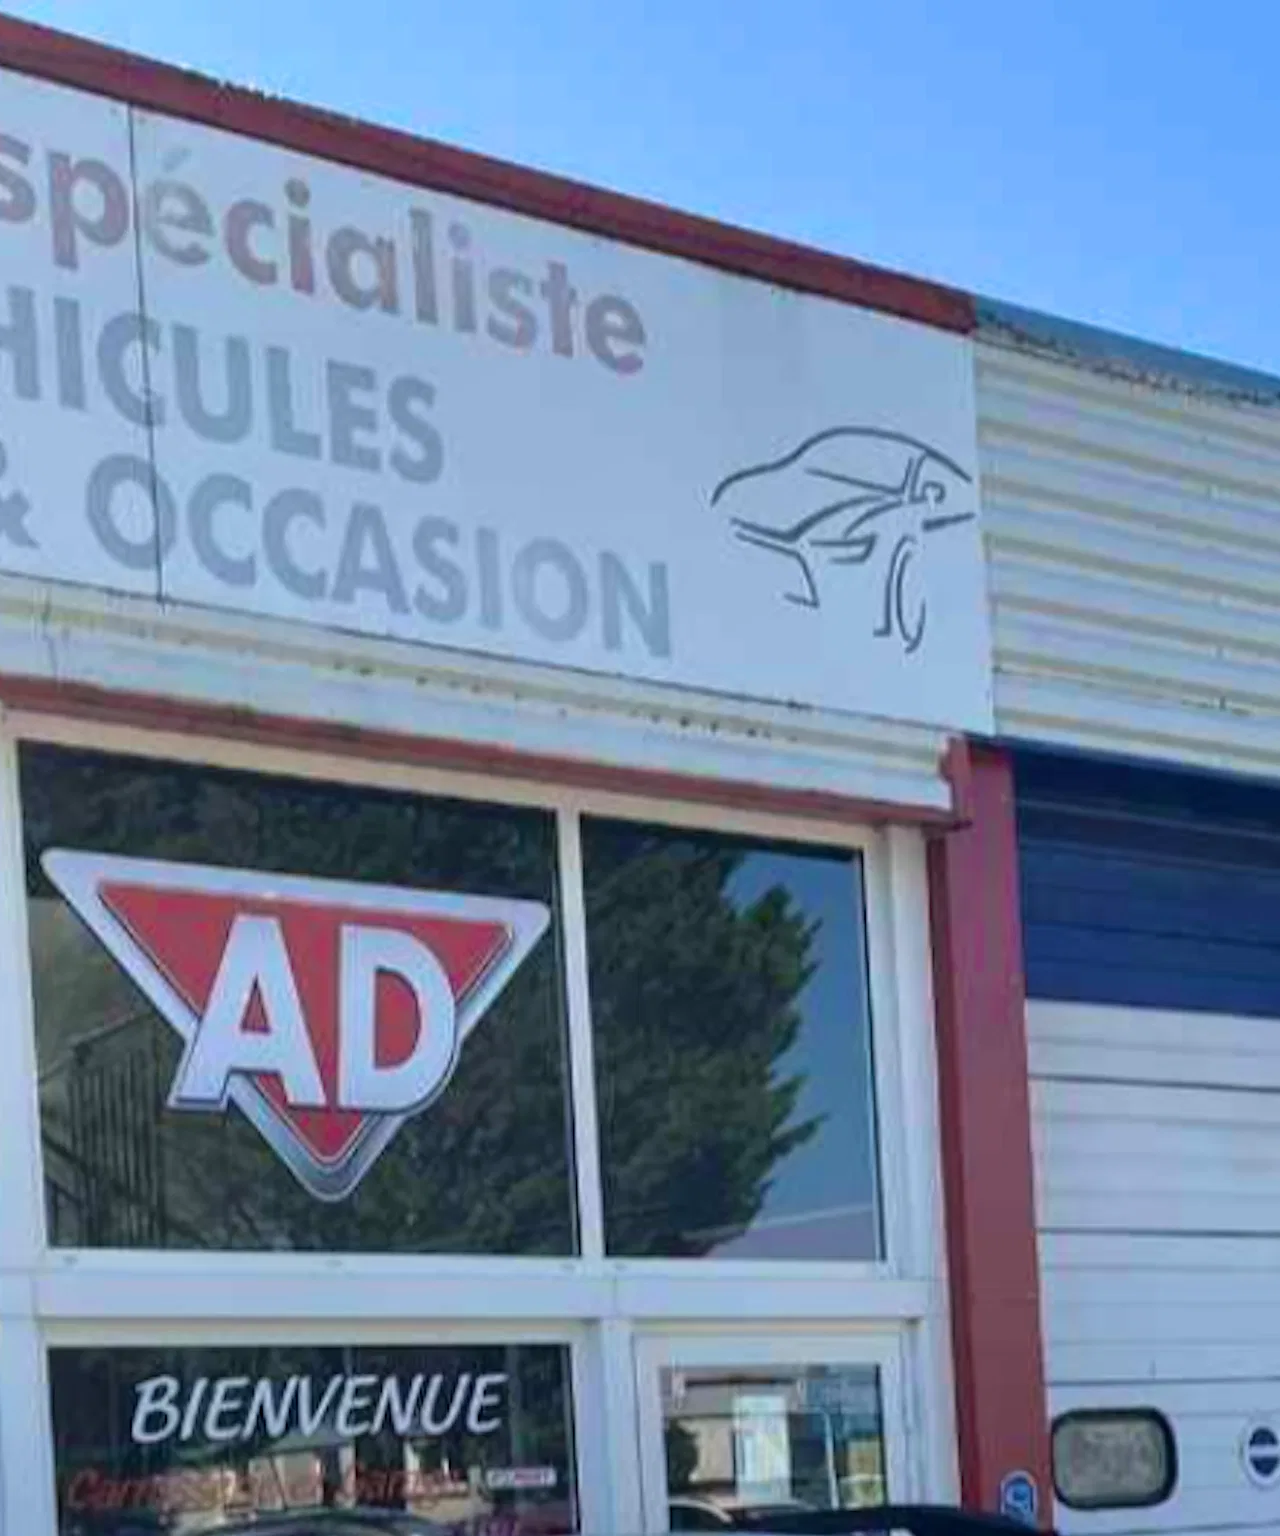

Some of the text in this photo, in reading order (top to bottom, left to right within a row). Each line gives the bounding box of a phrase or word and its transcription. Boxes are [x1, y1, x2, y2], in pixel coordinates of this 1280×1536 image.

[84, 452, 672, 658] OCCASION
[167, 913, 461, 1113] AD
[131, 1372, 509, 1444] BIENVENUE
